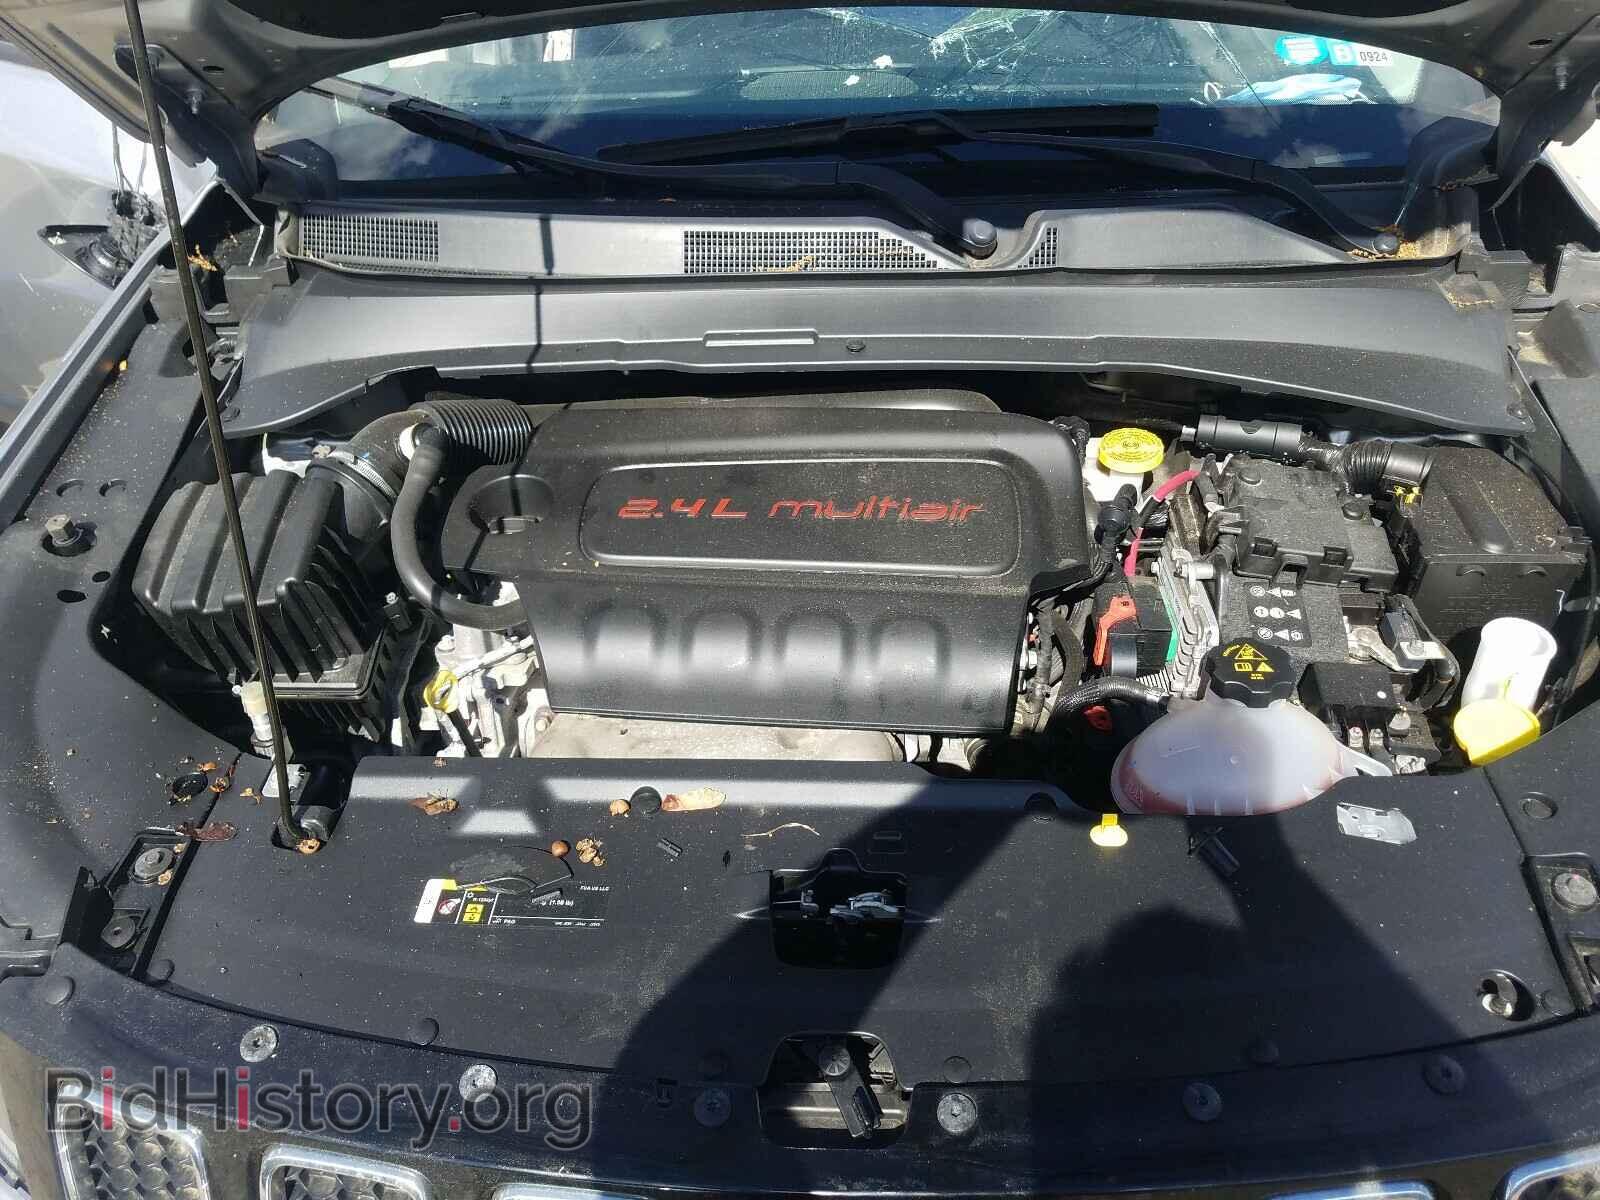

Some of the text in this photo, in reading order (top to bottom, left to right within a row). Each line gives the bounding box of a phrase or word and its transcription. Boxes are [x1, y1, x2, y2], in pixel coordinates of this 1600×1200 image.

[1359, 51, 1388, 62] 0924
[617, 495, 985, 522] 2.4L multiair
